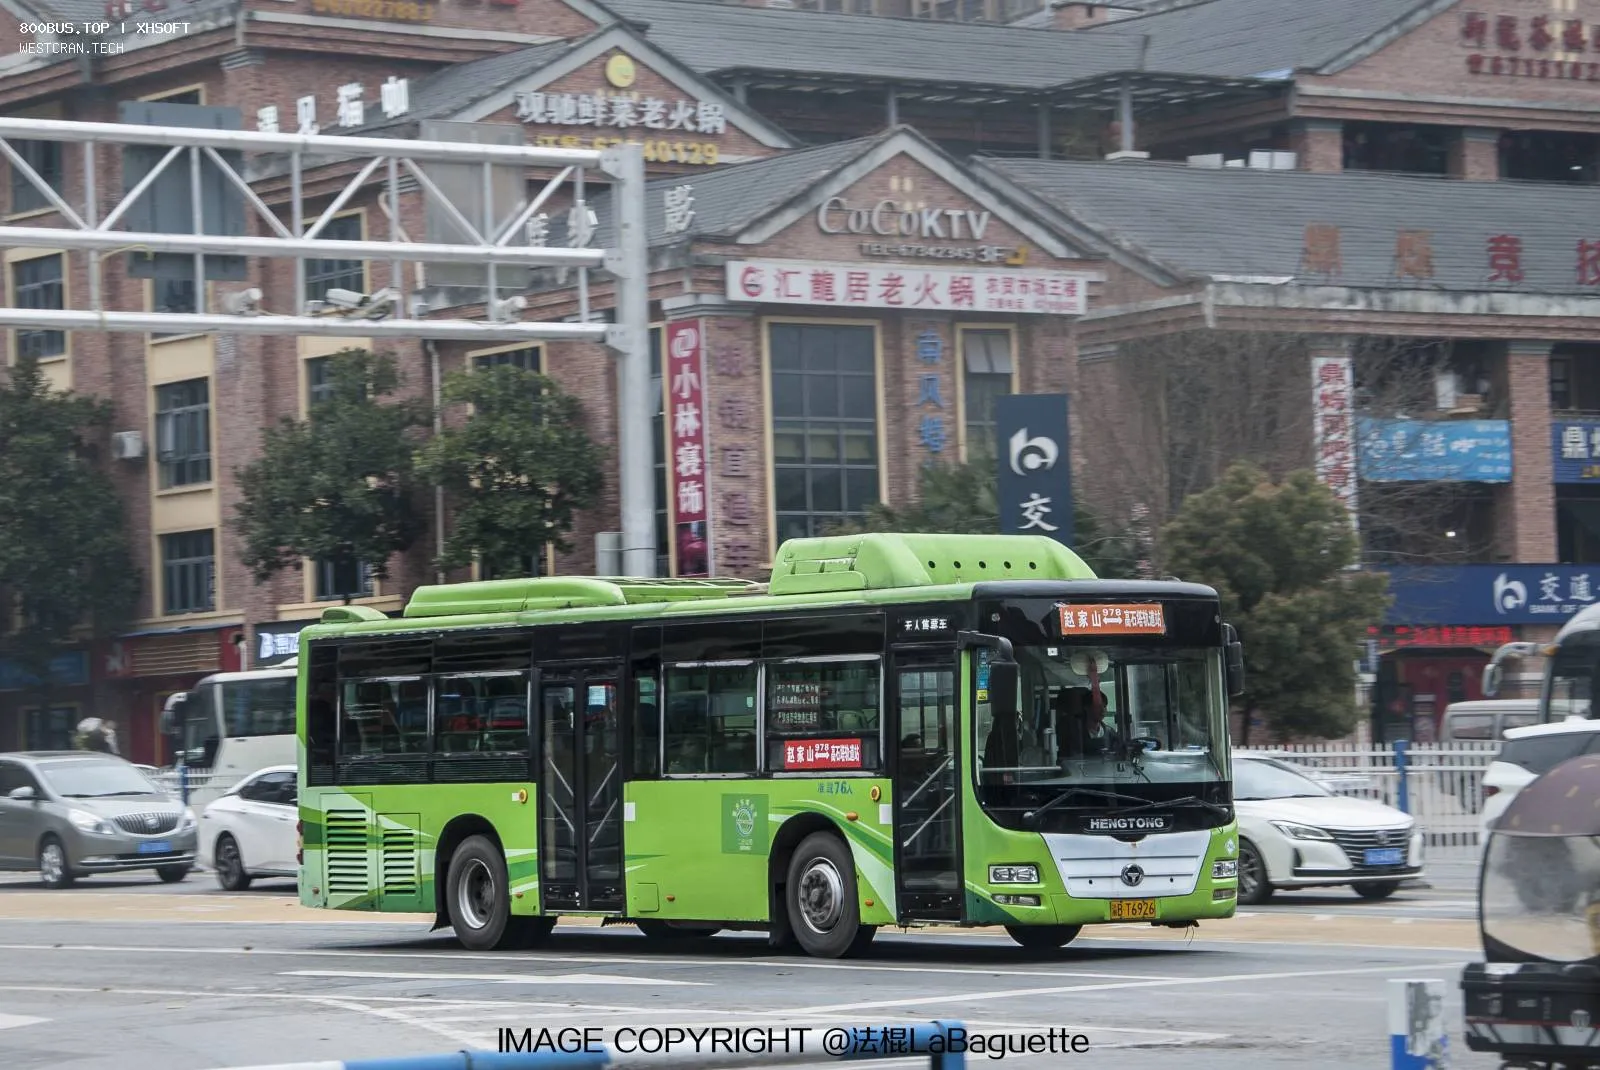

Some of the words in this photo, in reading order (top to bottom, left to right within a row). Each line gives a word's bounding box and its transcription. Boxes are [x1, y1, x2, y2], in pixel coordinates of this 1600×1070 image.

[1538, 571, 1600, 603] 交通
[1102, 608, 1122, 617] 978
[814, 743, 829, 752] 978
[1089, 818, 1164, 830] HENGTONG
